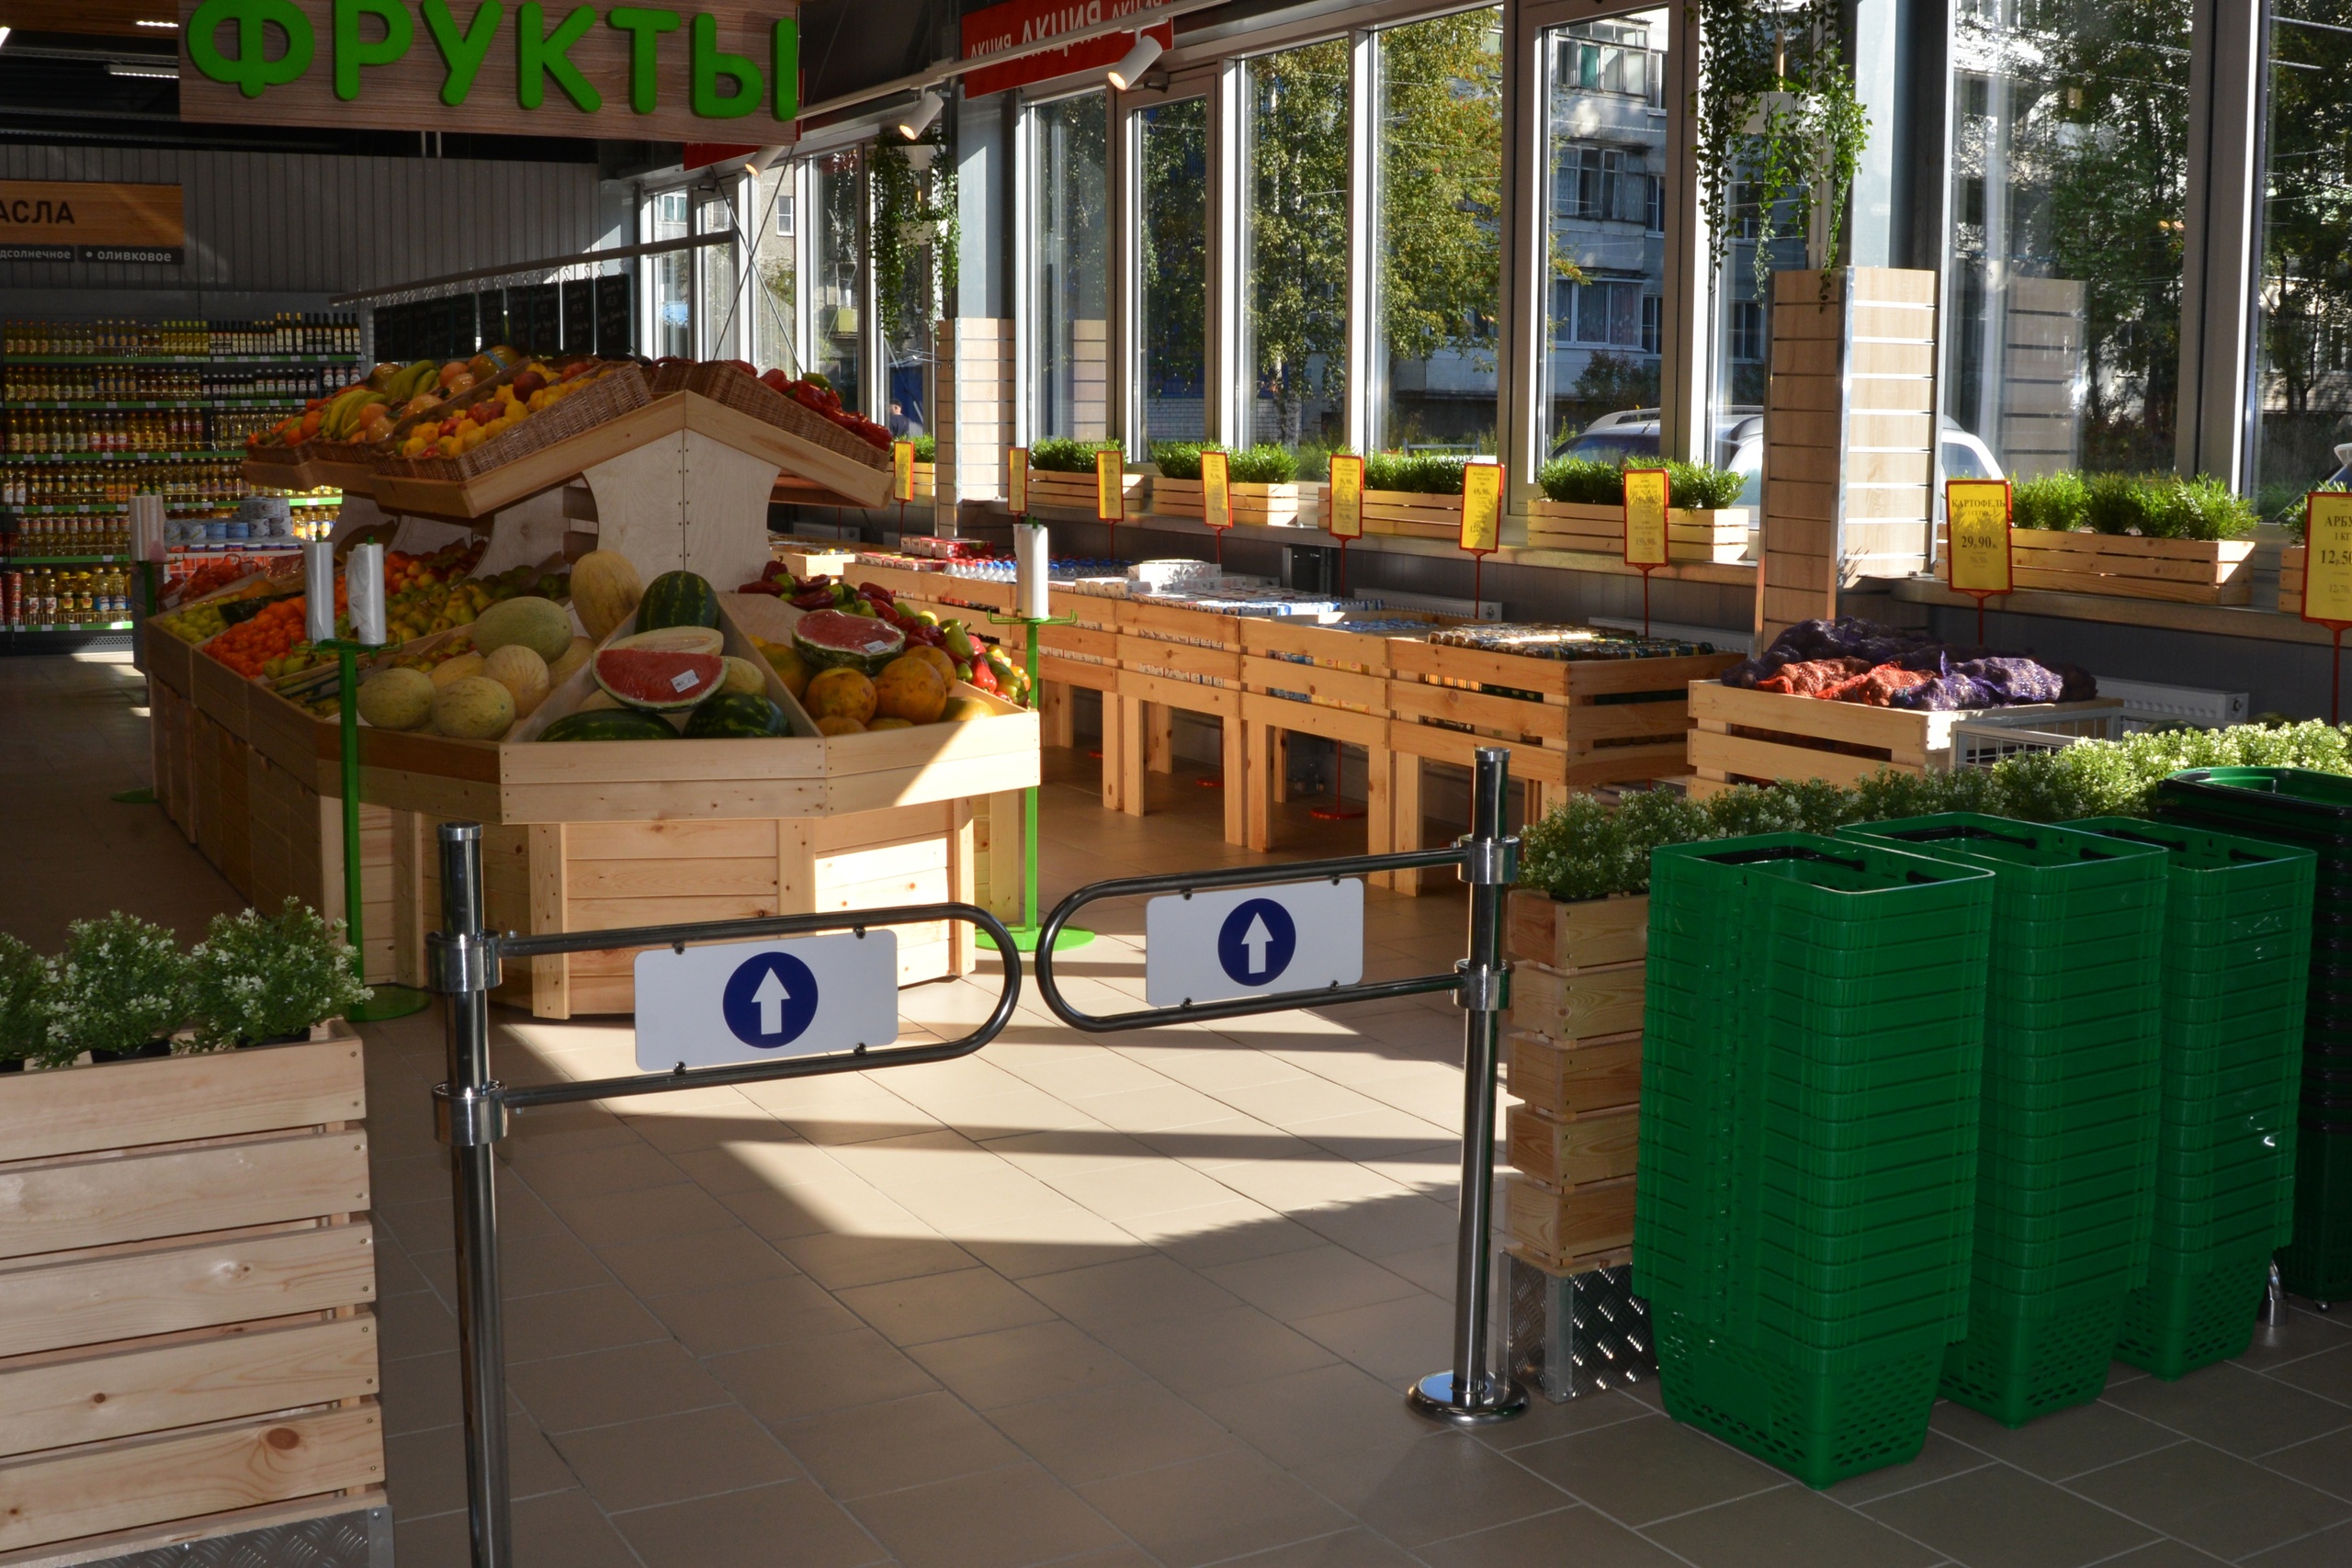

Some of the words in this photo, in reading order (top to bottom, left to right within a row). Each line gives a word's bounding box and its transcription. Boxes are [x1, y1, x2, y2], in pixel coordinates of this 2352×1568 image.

[187, 0, 798, 121] ФРУКТЫ
[97, 251, 172, 262] оливковое
[1951, 499, 2006, 508] КАРТОФЕЛЬ
